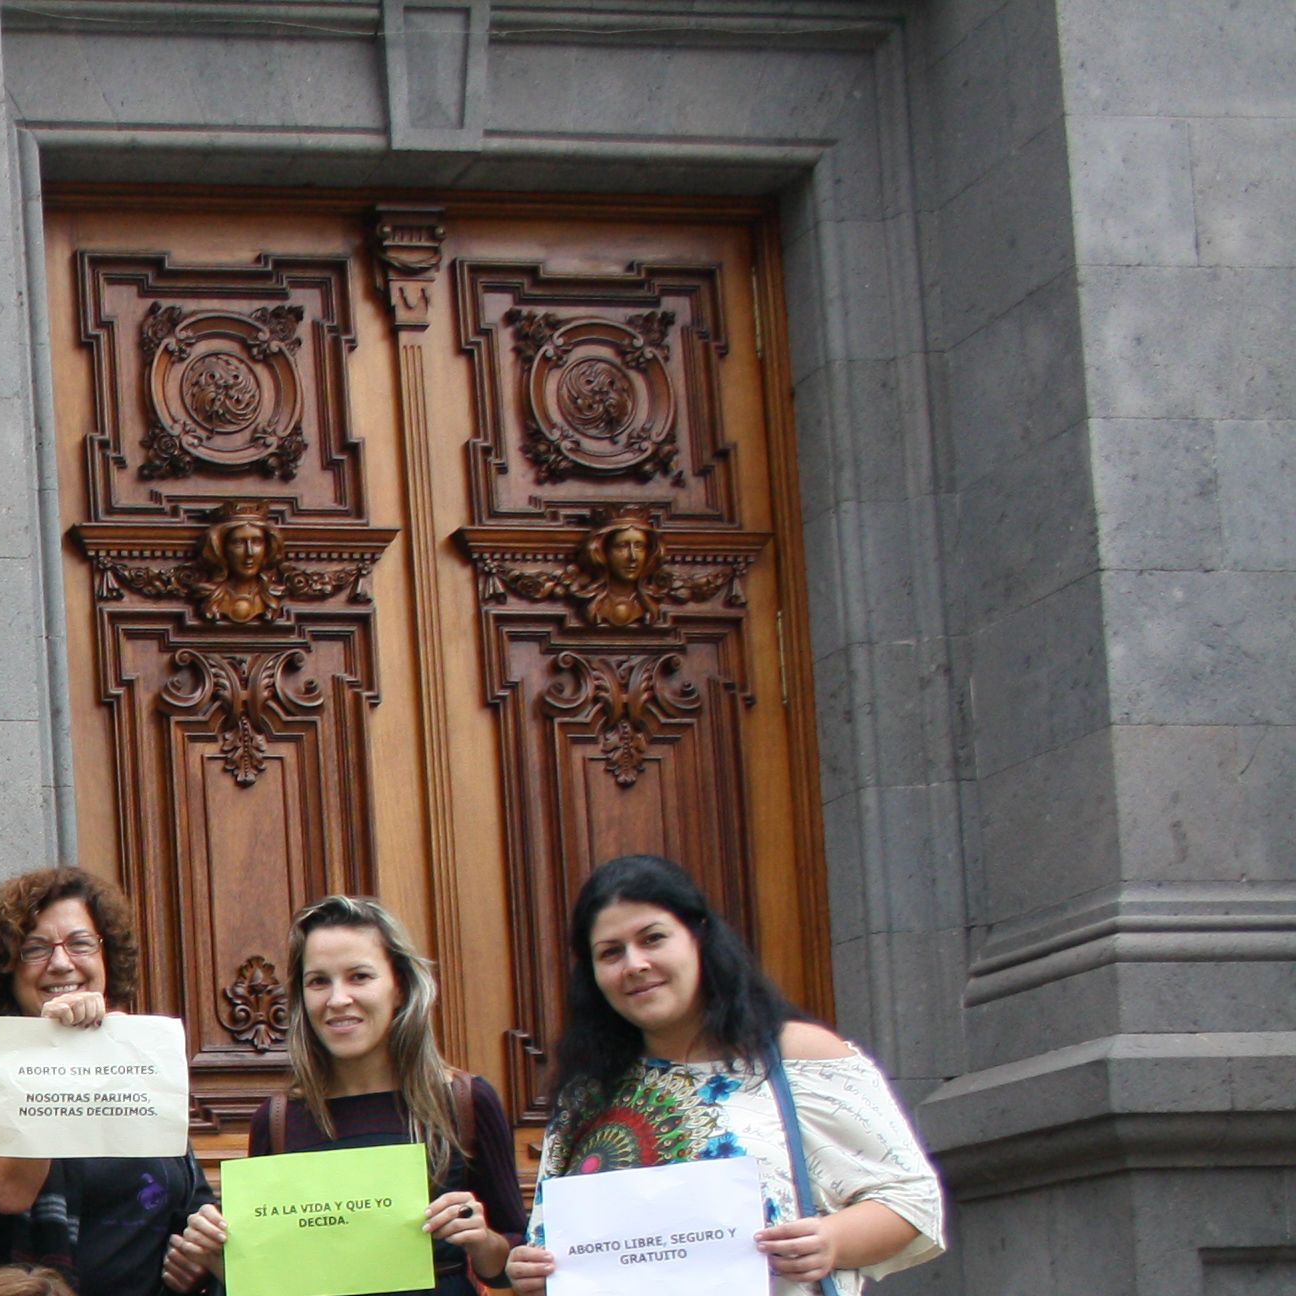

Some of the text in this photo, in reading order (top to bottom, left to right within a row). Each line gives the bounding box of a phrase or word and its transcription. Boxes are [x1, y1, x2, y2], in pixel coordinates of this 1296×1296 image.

[19, 1065, 157, 1075] ABORTO SIN RECORTES.
[27, 1093, 151, 1102] NOSOTRAS PARIMOS,
[19, 1107, 157, 1116] NOSOTRAS DECIDIMOS.
[255, 1198, 392, 1217] SÍ A LA VIDA Y QUE YO
[299, 1216, 349, 1227] DECIDA.
[569, 1228, 736, 1255] ABORTO LIBRE, SEGURO Y
[620, 1249, 687, 1264] GRATUITO
